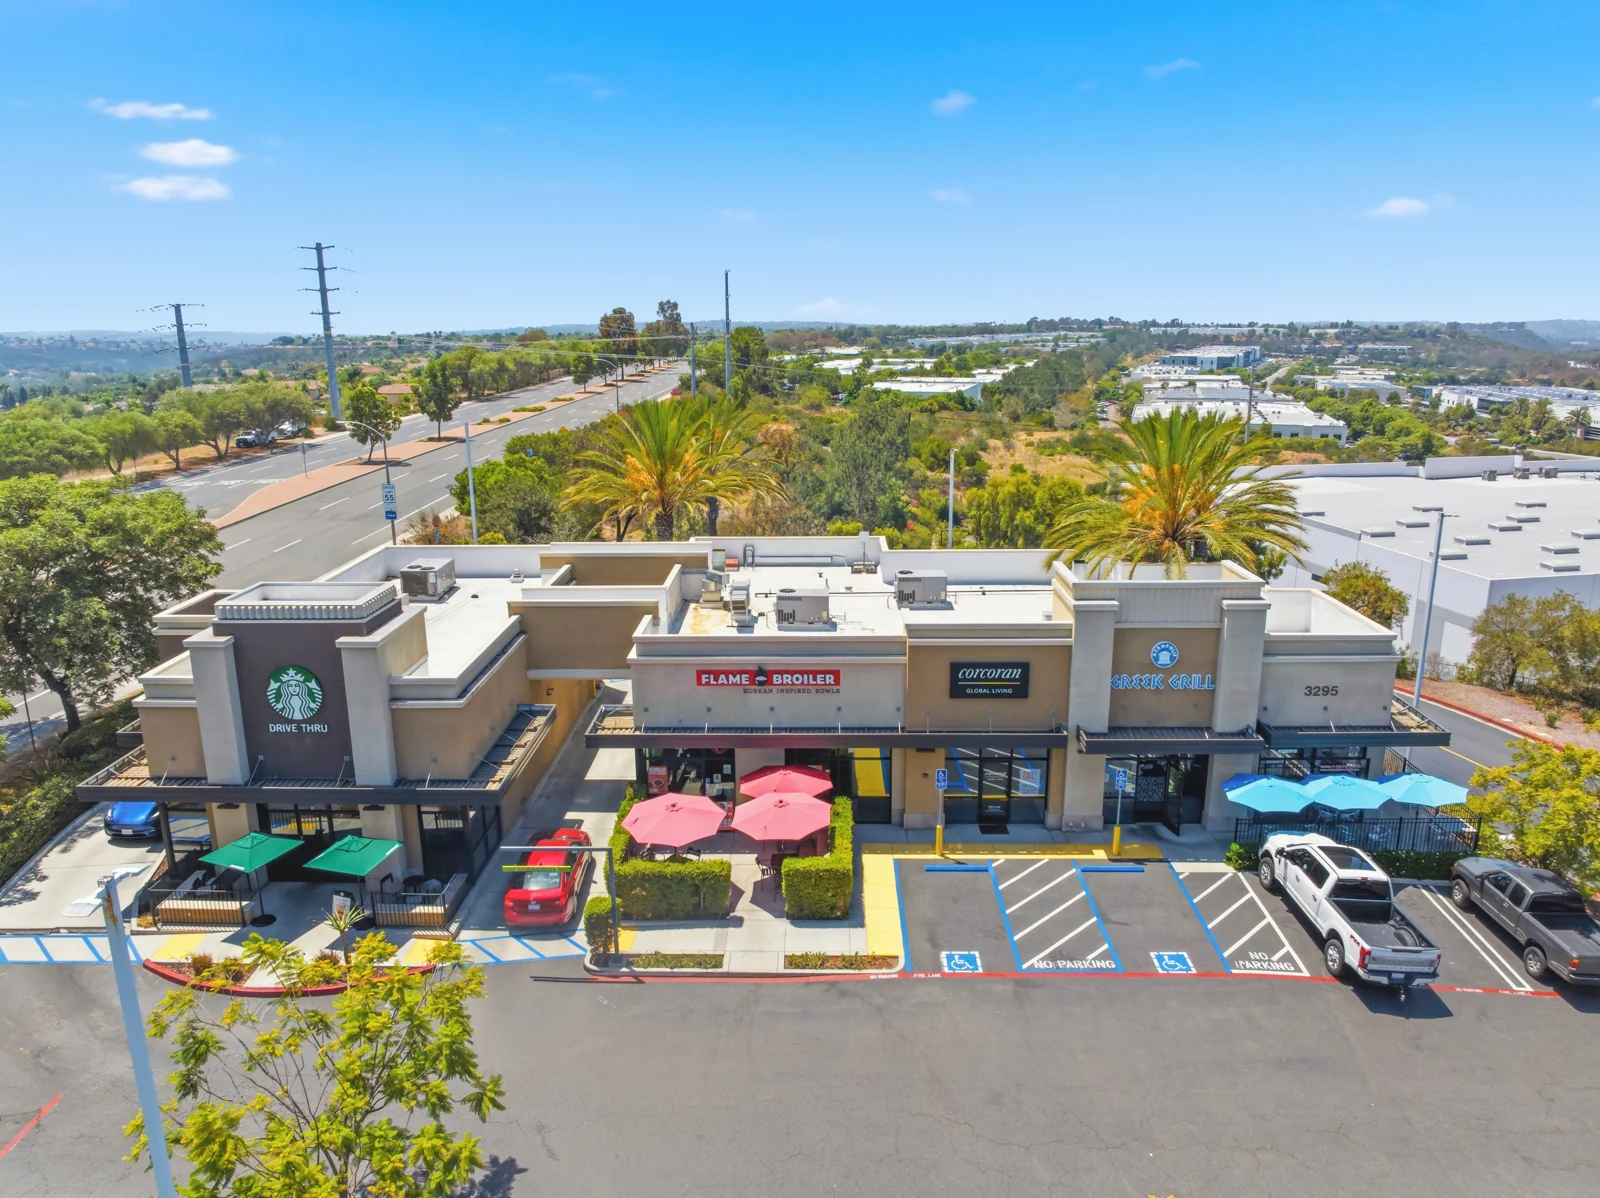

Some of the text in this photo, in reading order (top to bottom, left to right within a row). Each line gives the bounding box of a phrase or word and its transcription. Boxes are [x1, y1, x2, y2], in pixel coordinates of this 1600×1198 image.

[958, 668, 1022, 679] corcoran
[701, 674, 836, 685] FLAME BROILER
[1110, 673, 1216, 690] GREEK GRILL
[1303, 685, 1339, 697] 3295
[269, 723, 328, 732] DRIVE THRU
[1248, 951, 1269, 960] NO
[1033, 960, 1116, 970] NO PARKING
[1234, 960, 1295, 971] PARKING
